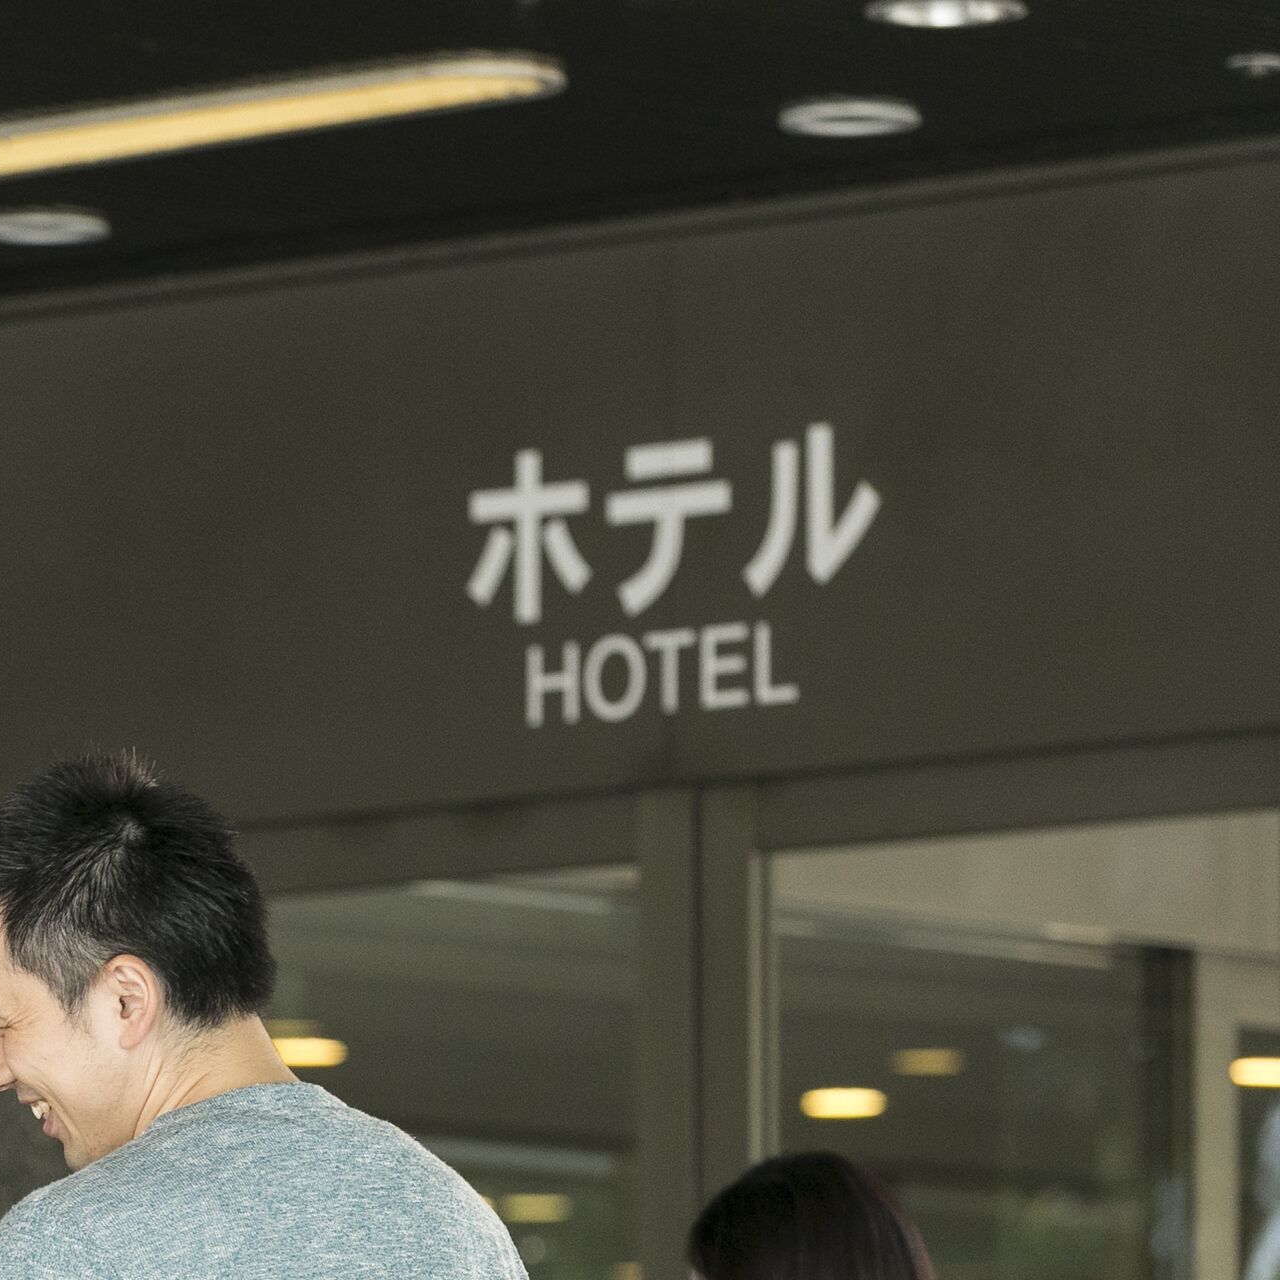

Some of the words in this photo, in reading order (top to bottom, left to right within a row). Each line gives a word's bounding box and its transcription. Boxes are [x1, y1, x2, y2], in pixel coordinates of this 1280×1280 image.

[465, 420, 883, 626] ホテル
[524, 620, 801, 730] HOTEL
